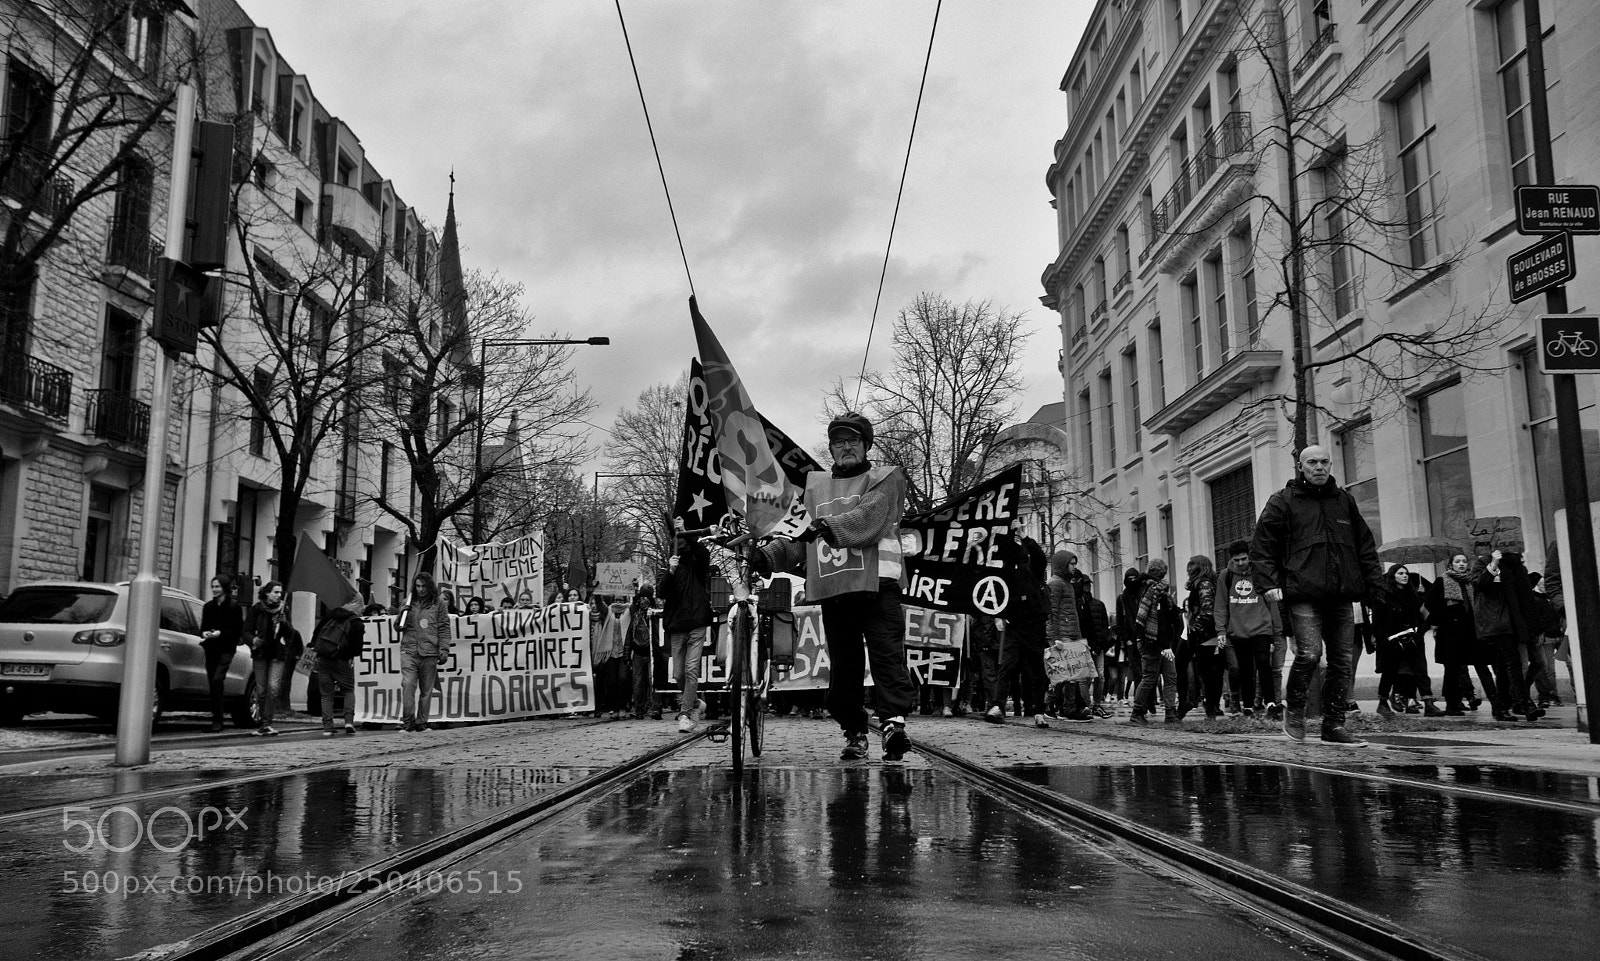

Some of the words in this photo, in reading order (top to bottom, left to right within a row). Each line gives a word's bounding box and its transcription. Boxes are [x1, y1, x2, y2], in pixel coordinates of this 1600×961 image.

[1548, 192, 1570, 204] RUE
[1525, 207, 1550, 219] Jean
[1552, 207, 1596, 219] RENAUD
[1513, 242, 1563, 275] BOULEVARD
[1514, 280, 1525, 292] de
[1526, 259, 1566, 286] BROSSES
[442, 539, 459, 562] NI
[442, 562, 458, 582] NI
[492, 602, 583, 640] OUVRIERS
[428, 671, 588, 720] SOLIDAIRES
